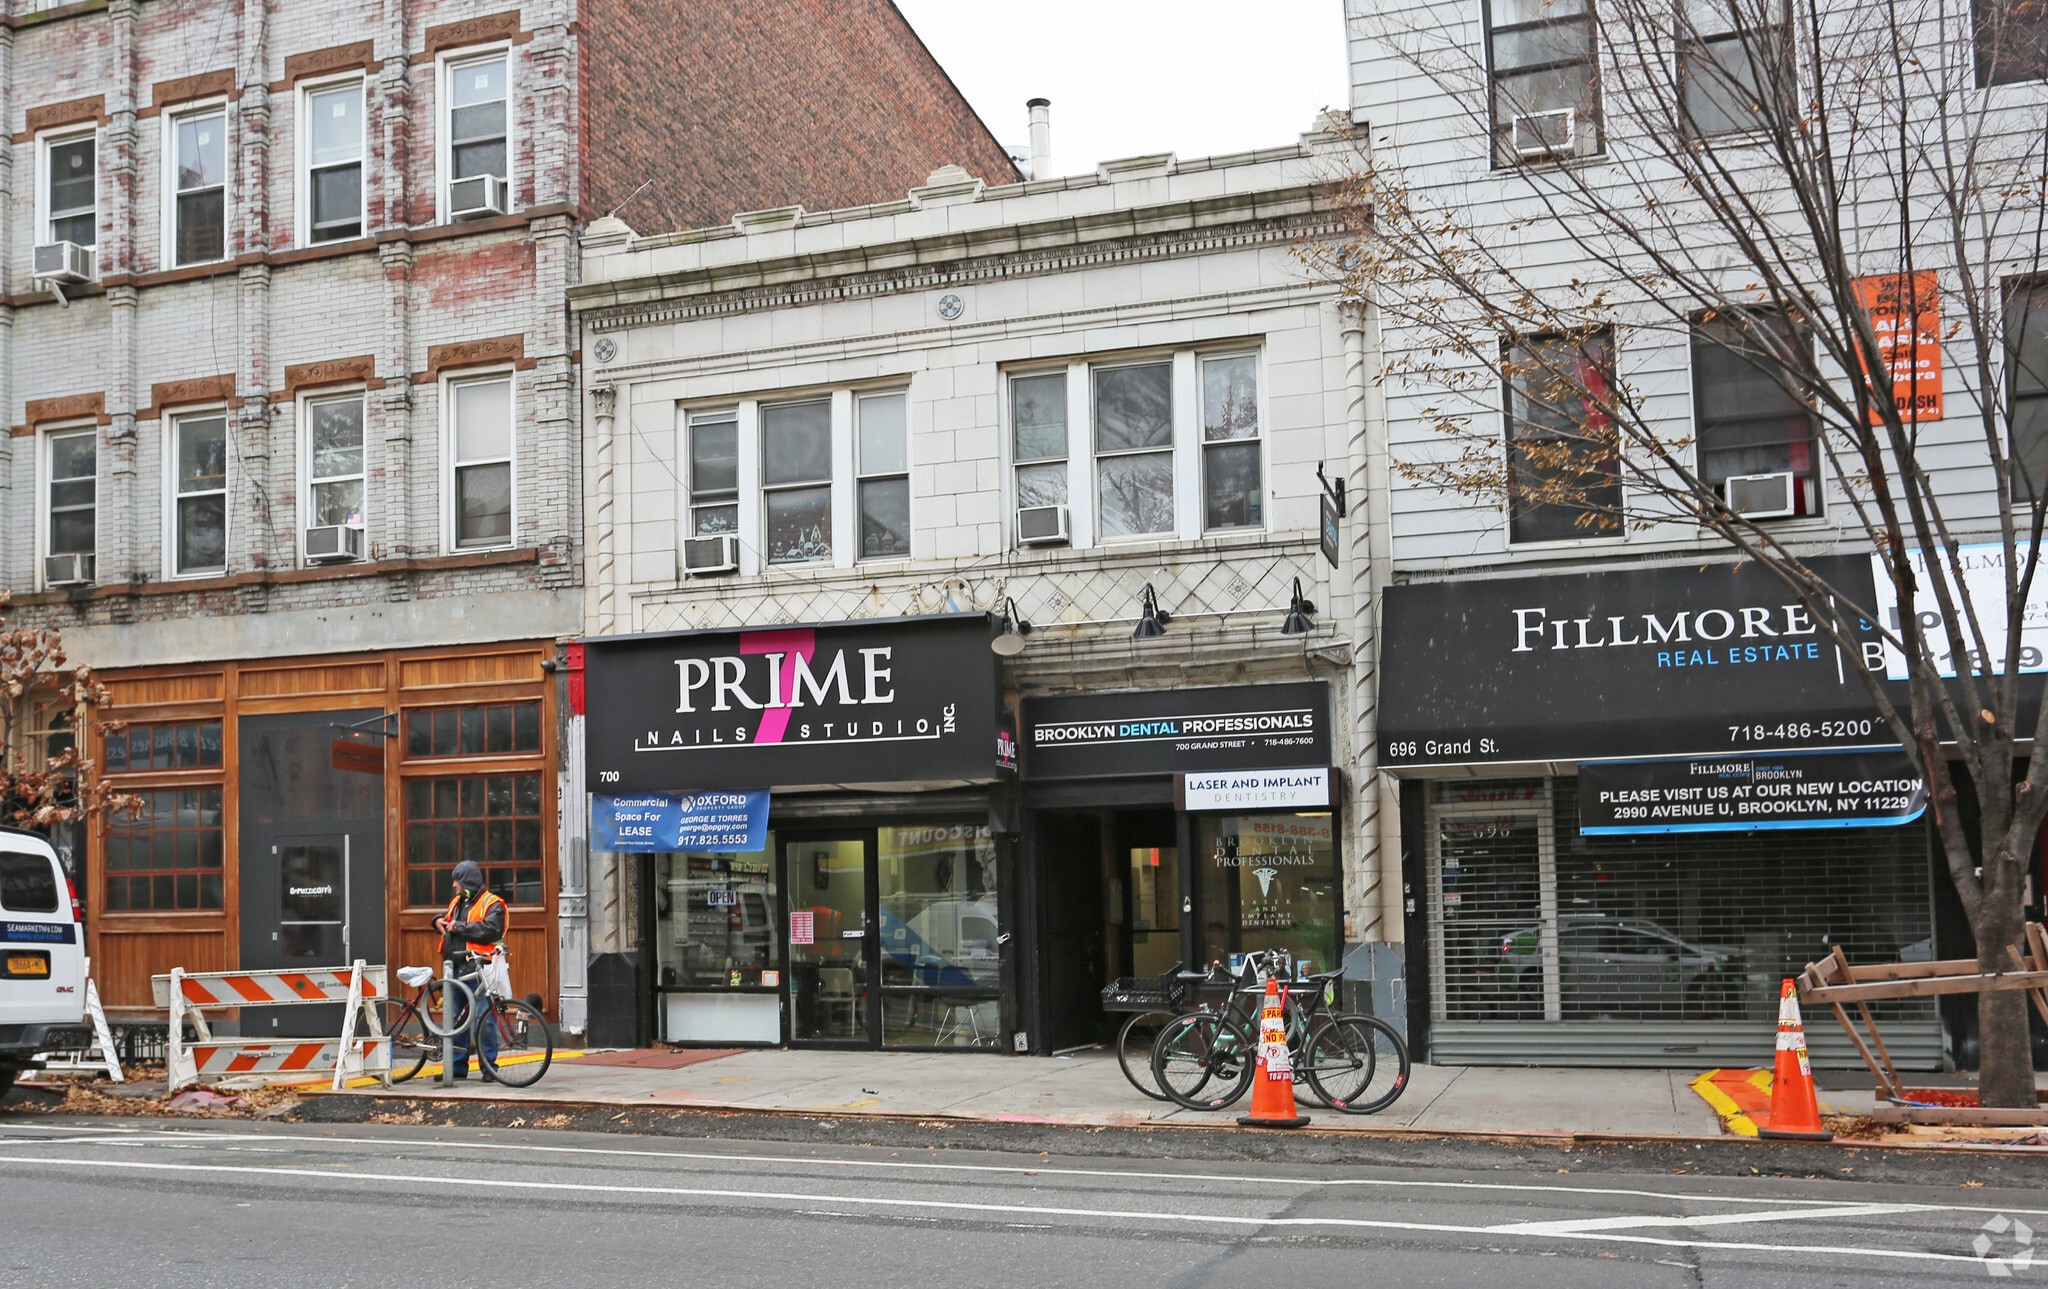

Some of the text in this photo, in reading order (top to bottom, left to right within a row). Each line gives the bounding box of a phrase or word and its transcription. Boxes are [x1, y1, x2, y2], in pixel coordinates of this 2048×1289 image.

[1511, 604, 1817, 653] FILLMORE
[1657, 642, 1820, 668] REAL ESTATE
[674, 646, 895, 713] PRIME
[943, 703, 956, 734] INC.
[647, 719, 928, 745] NAILS STUDIO
[1034, 714, 1313, 741] BROOKLYN DENTAL PROFESSIONALS
[1728, 719, 1872, 742] 718-486-5200
[1190, 742, 1219, 750] GRAND
[1220, 740, 1246, 749] STREET
[1264, 737, 1314, 746] 718-486-7600
[1389, 738, 1500, 757] 696 Grand St.
[1690, 762, 1750, 776] FILLMORE
[1755, 770, 1803, 780] BROOKLYN
[600, 771, 620, 782] 700
[1189, 776, 1322, 790] LASER AND IMPLANT
[1214, 791, 1298, 802] DENTISTRY
[1600, 778, 1923, 804] PLEASE VISIT US AT OUR NEW LOCATION
[613, 797, 668, 808] Commercial
[697, 794, 747, 805] OXFORD
[1614, 796, 1909, 819] 2990 AVENUE U, BROOKLYN, NY 11229
[615, 812, 661, 822] Space For
[680, 816, 709, 824] GEORGE
[619, 826, 652, 836] LEASE
[679, 823, 748, 833] george@opgny.com
[677, 834, 748, 846] 917.825.5553
[1216, 836, 1313, 847] BROOKLYN
[1216, 845, 1315, 856] DENTAL
[1216, 855, 1315, 867] PROFESSIONALS
[709, 892, 735, 904] OPEN
[7, 924, 63, 933] SEAMARKETNY.COM
